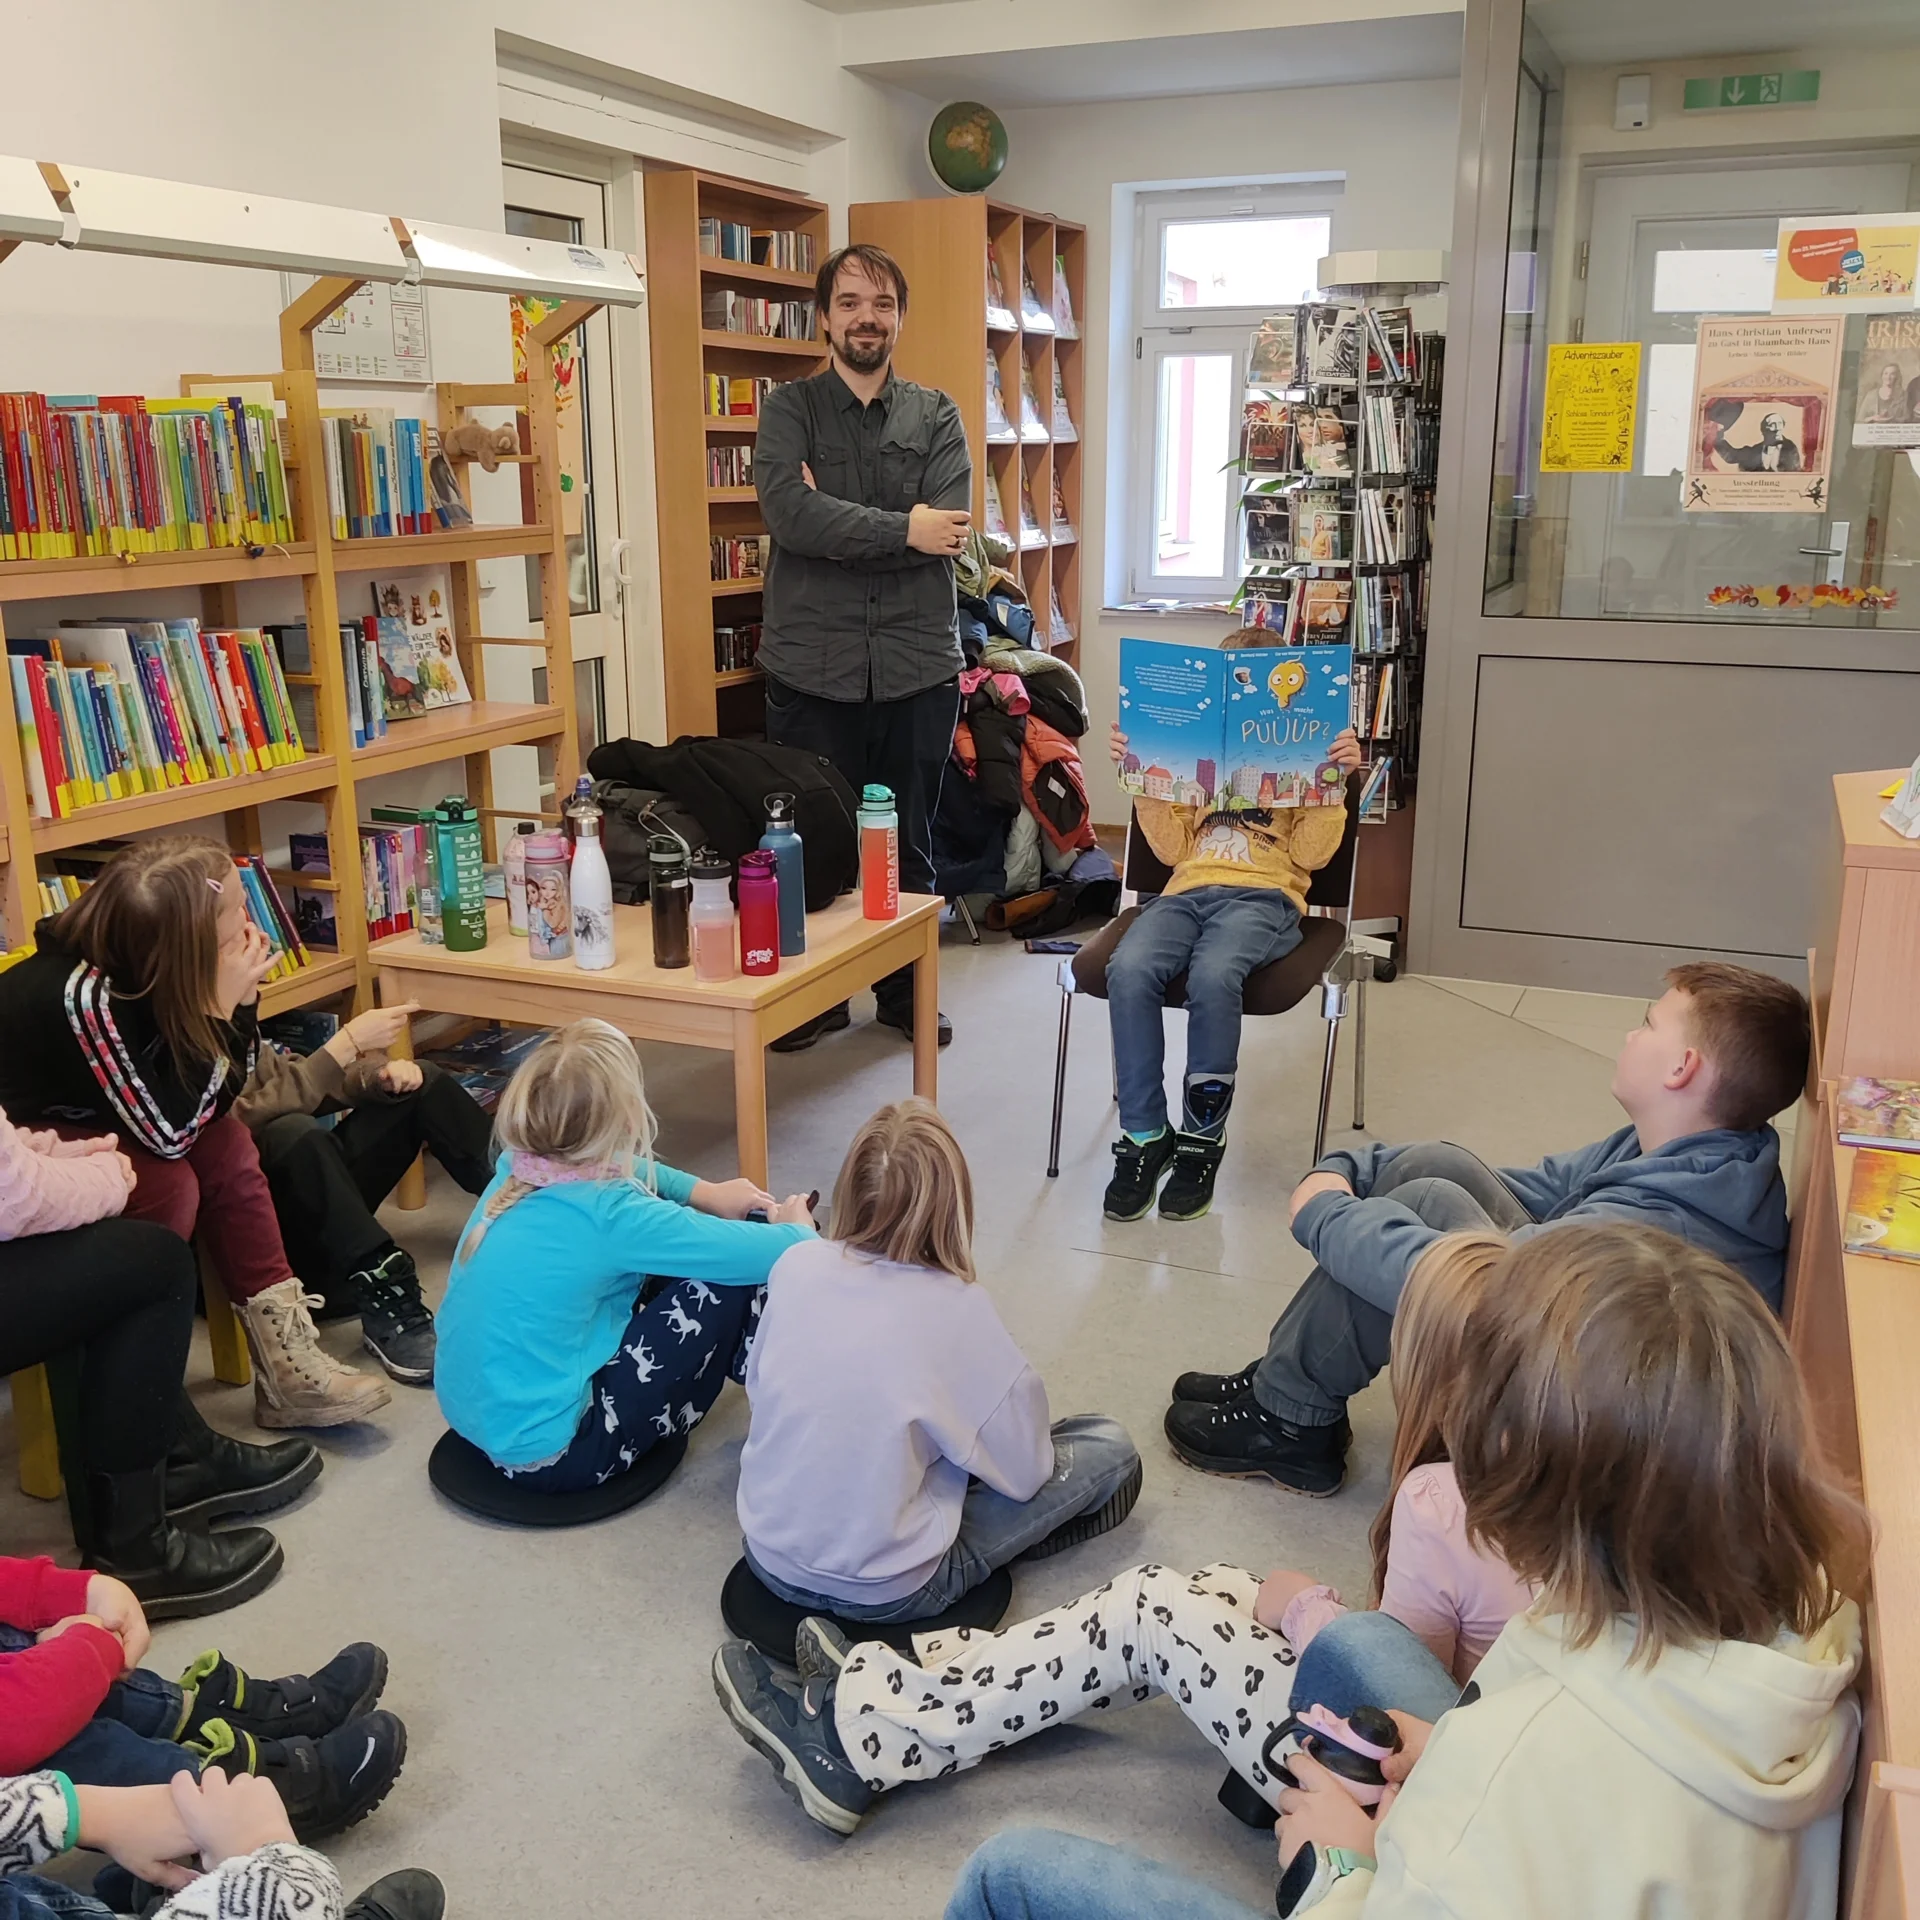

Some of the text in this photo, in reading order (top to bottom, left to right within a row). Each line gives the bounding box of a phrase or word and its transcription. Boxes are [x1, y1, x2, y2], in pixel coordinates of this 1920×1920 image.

[1708, 327, 1832, 338] Hans Christian Andersen
[1754, 338, 1805, 346] Baumbachs
[1564, 350, 1624, 360] Adventszauber
[1733, 479, 1780, 487] Ausstellung
[360, 647, 368, 687] OSTWIND
[1260, 708, 1274, 716] Was
[887, 827, 897, 909] HYDRATED
